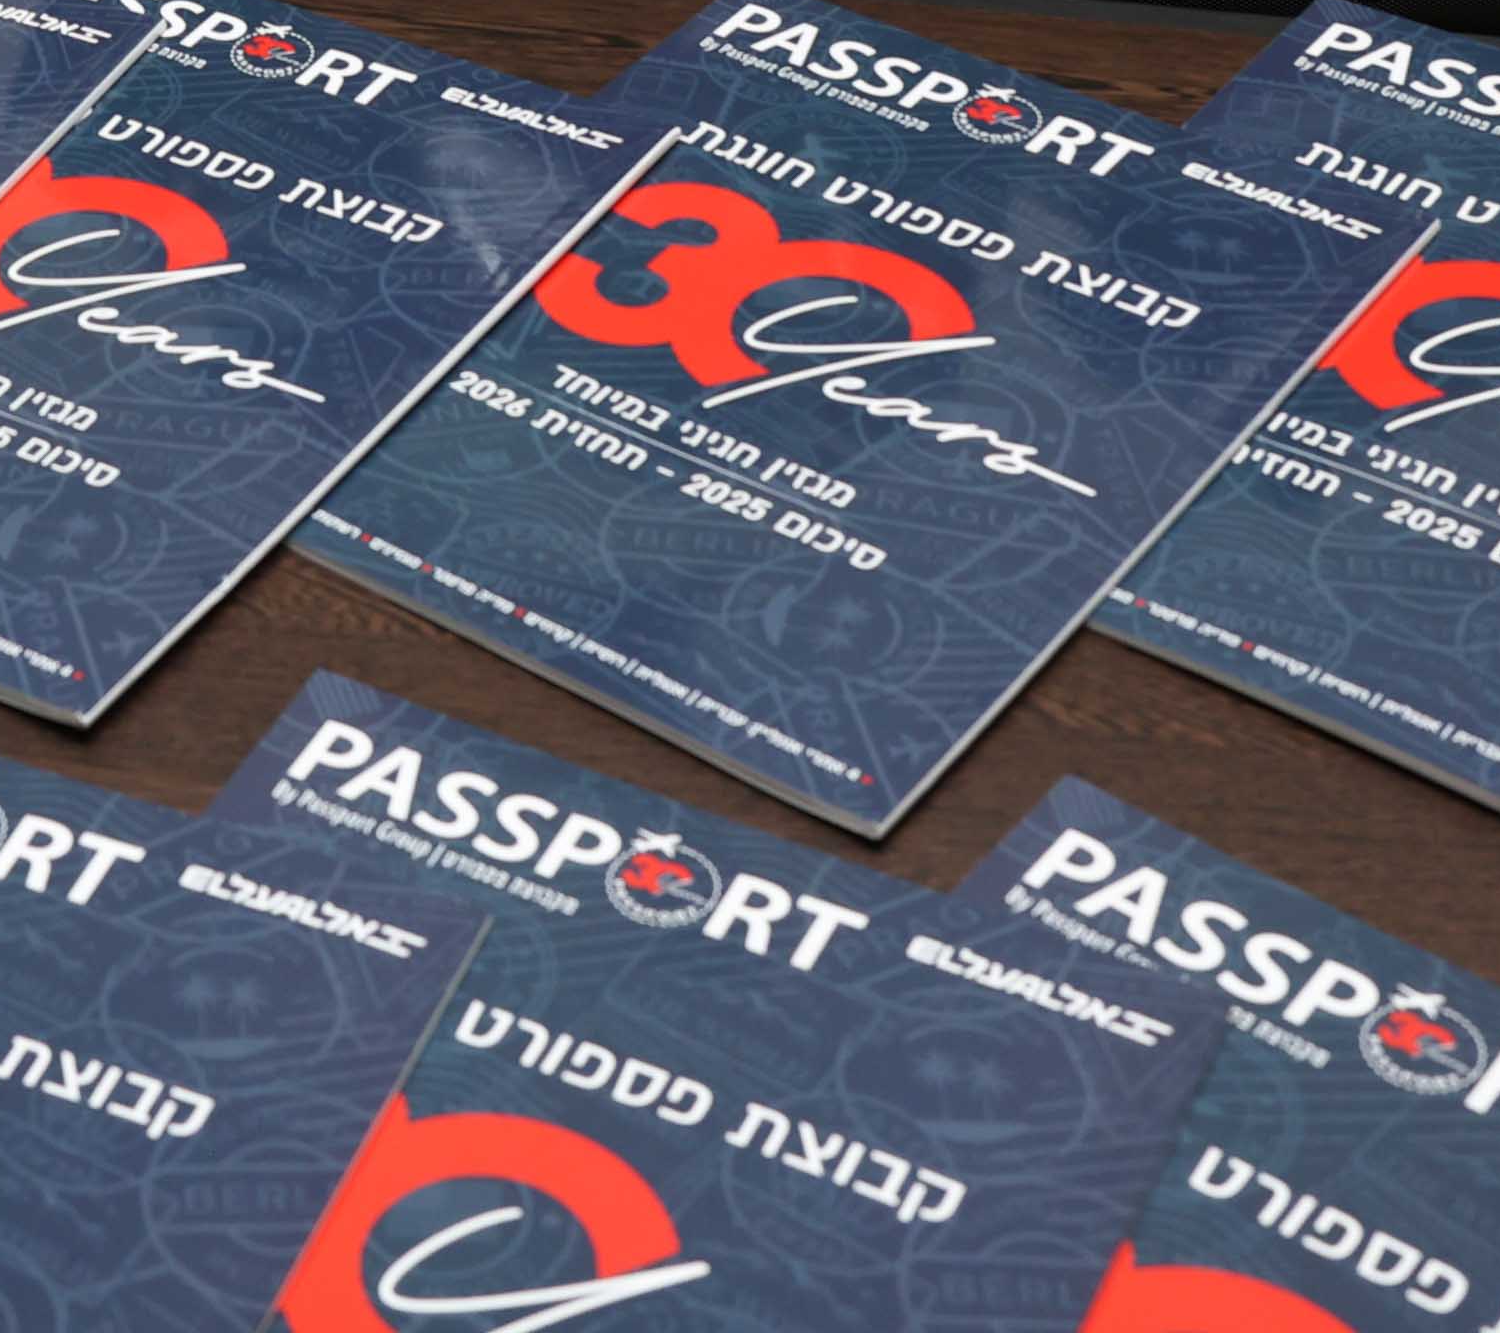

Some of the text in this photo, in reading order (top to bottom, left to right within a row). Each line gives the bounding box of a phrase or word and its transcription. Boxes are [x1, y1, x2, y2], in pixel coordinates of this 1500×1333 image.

[713, 0, 1156, 178] PASSPORT
[98, 112, 445, 245] קבוצת פספורט
[824, 174, 1015, 263] פספורט
[1294, 139, 1444, 213] חוגגת
[1021, 248, 1201, 333] קבוצת
[7, 387, 98, 431] מגזין
[17, 434, 120, 487] סיכום
[554, 364, 857, 509] מגזין חגיגי במיוחד
[450, 370, 886, 572] סיכום 2025 תחזית 2026
[1367, 445, 1458, 493] חגיגי
[1384, 499, 1483, 550] 2025
[286, 719, 870, 971] PASSPORT
[455, 999, 966, 1226] קבוצת פספורט
[1189, 1145, 1470, 1316] פספורט
